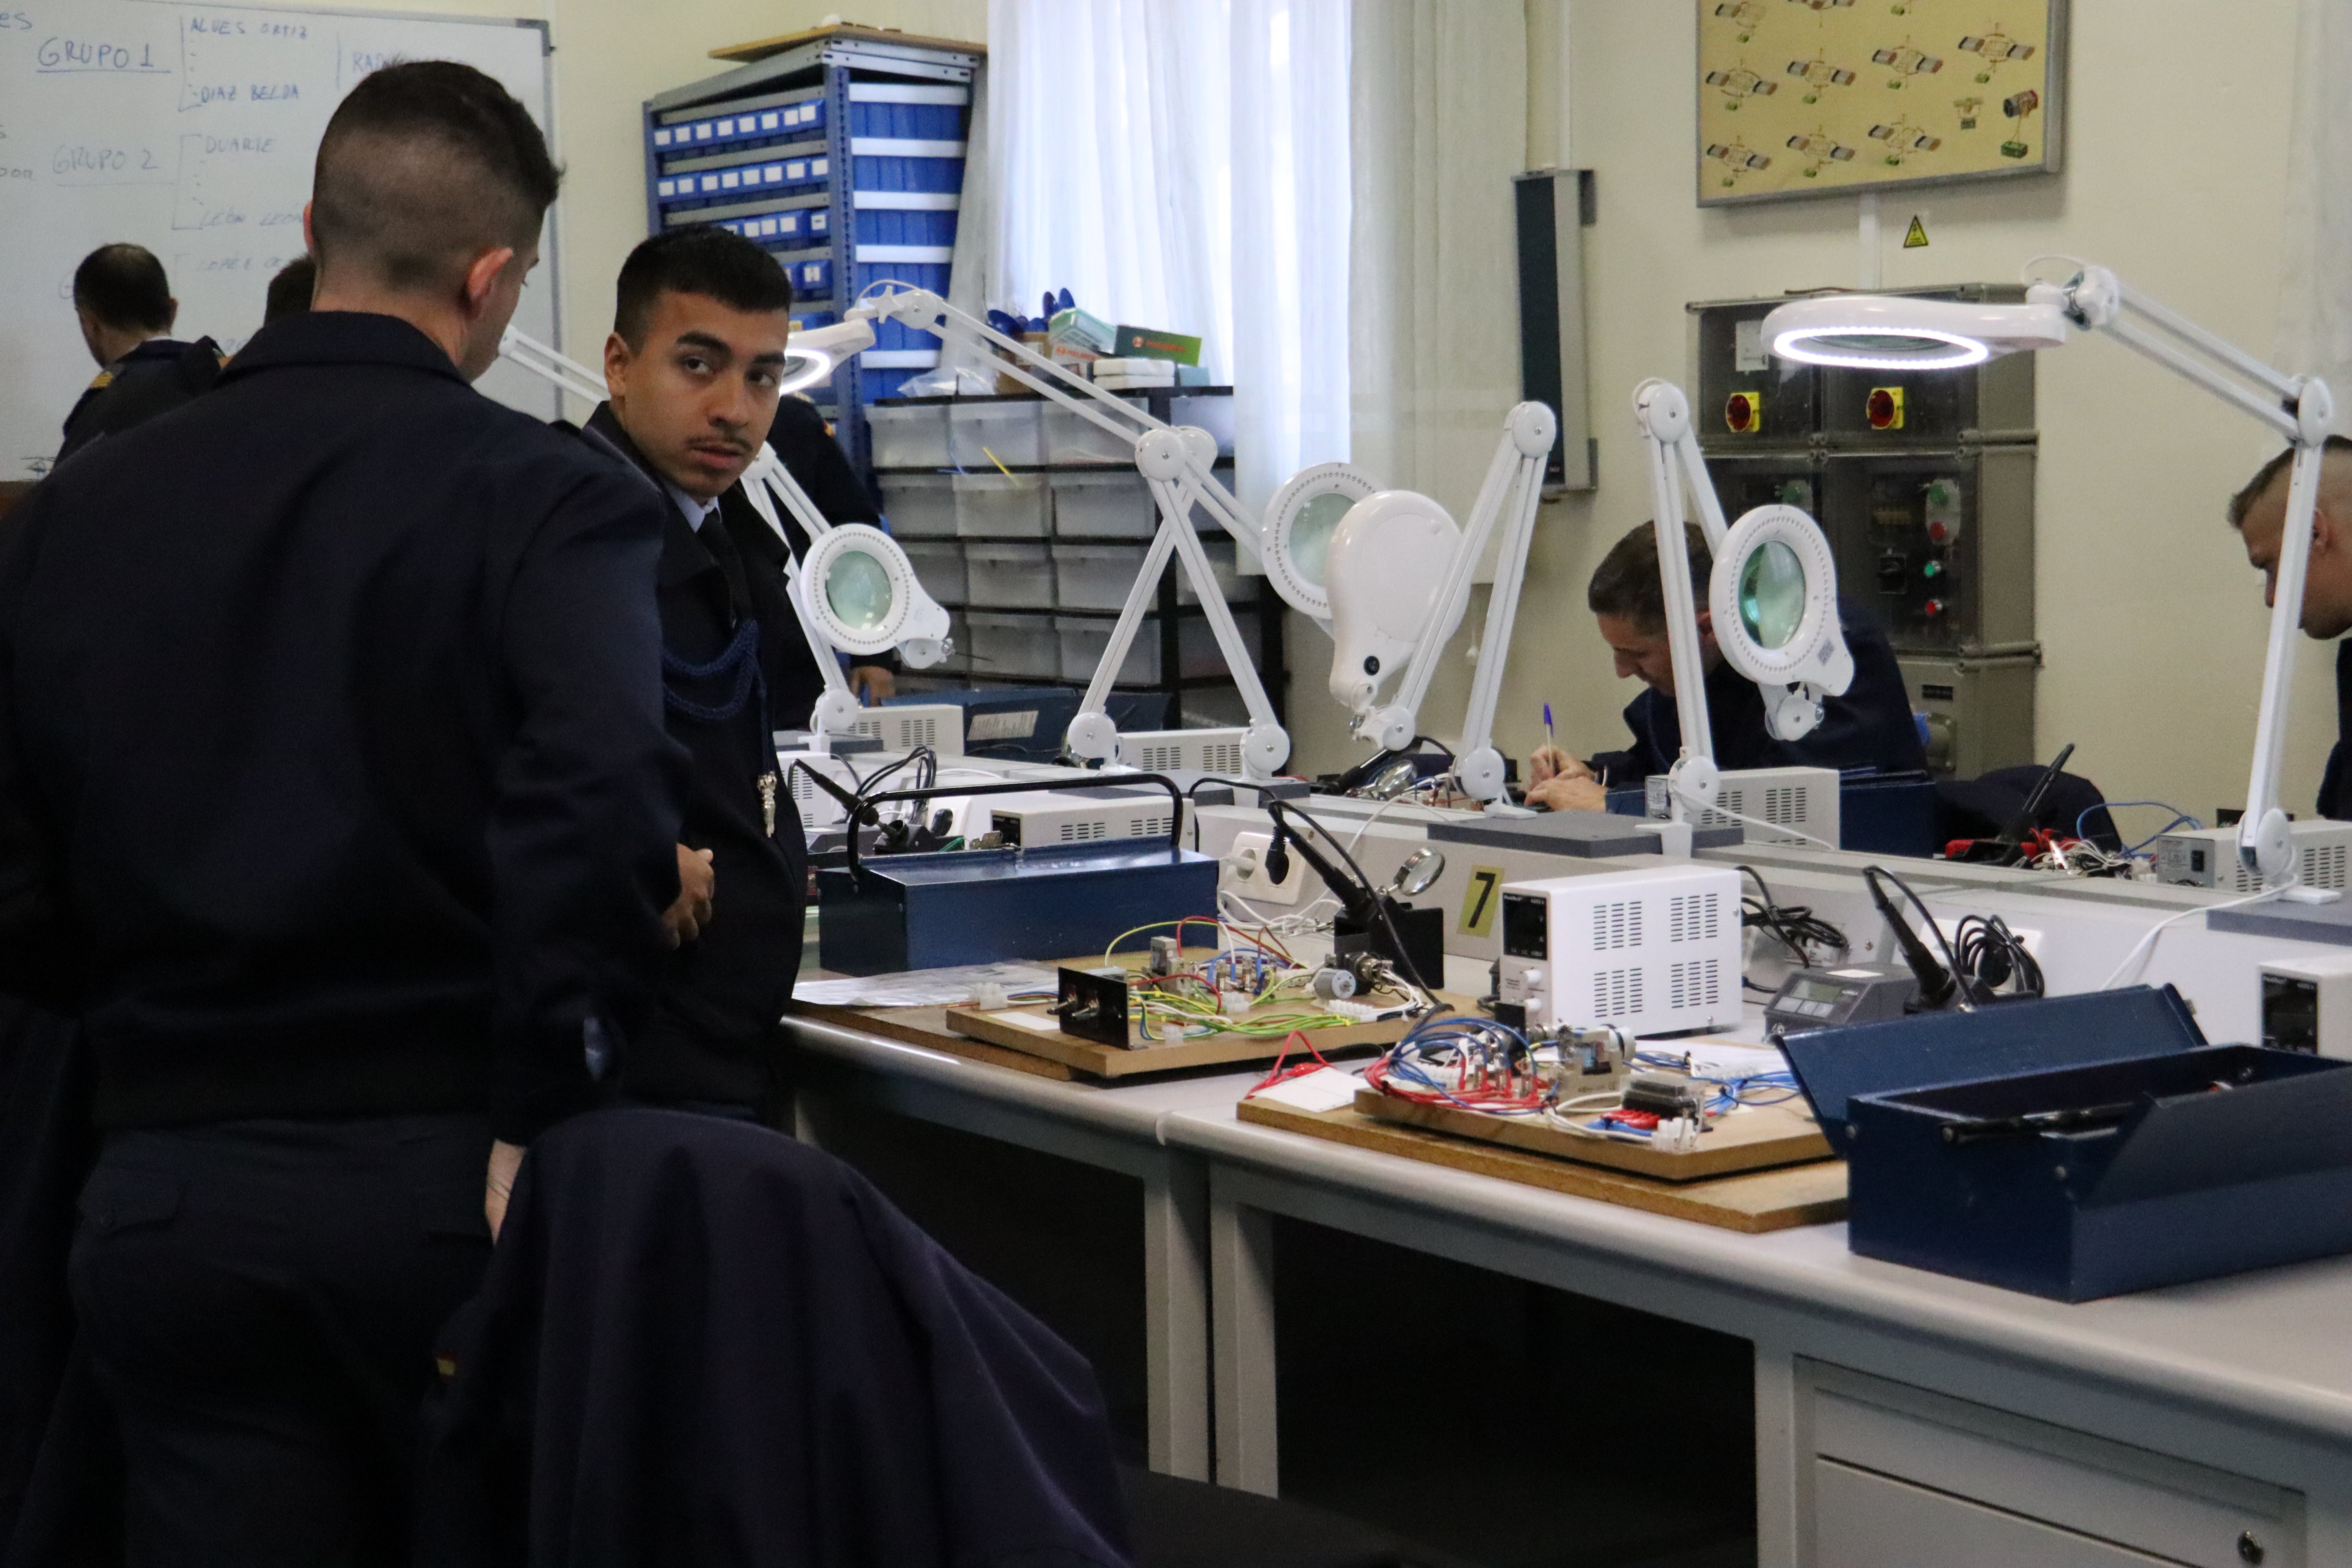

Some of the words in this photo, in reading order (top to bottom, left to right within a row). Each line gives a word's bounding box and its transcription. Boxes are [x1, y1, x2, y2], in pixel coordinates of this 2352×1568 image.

[39, 37, 129, 68] GRUPO
[140, 44, 154, 67] 1
[53, 145, 127, 174] GRUPO
[142, 150, 160, 169] 2
[206, 136, 276, 153] DUARTE
[1468, 871, 1496, 928] 7
